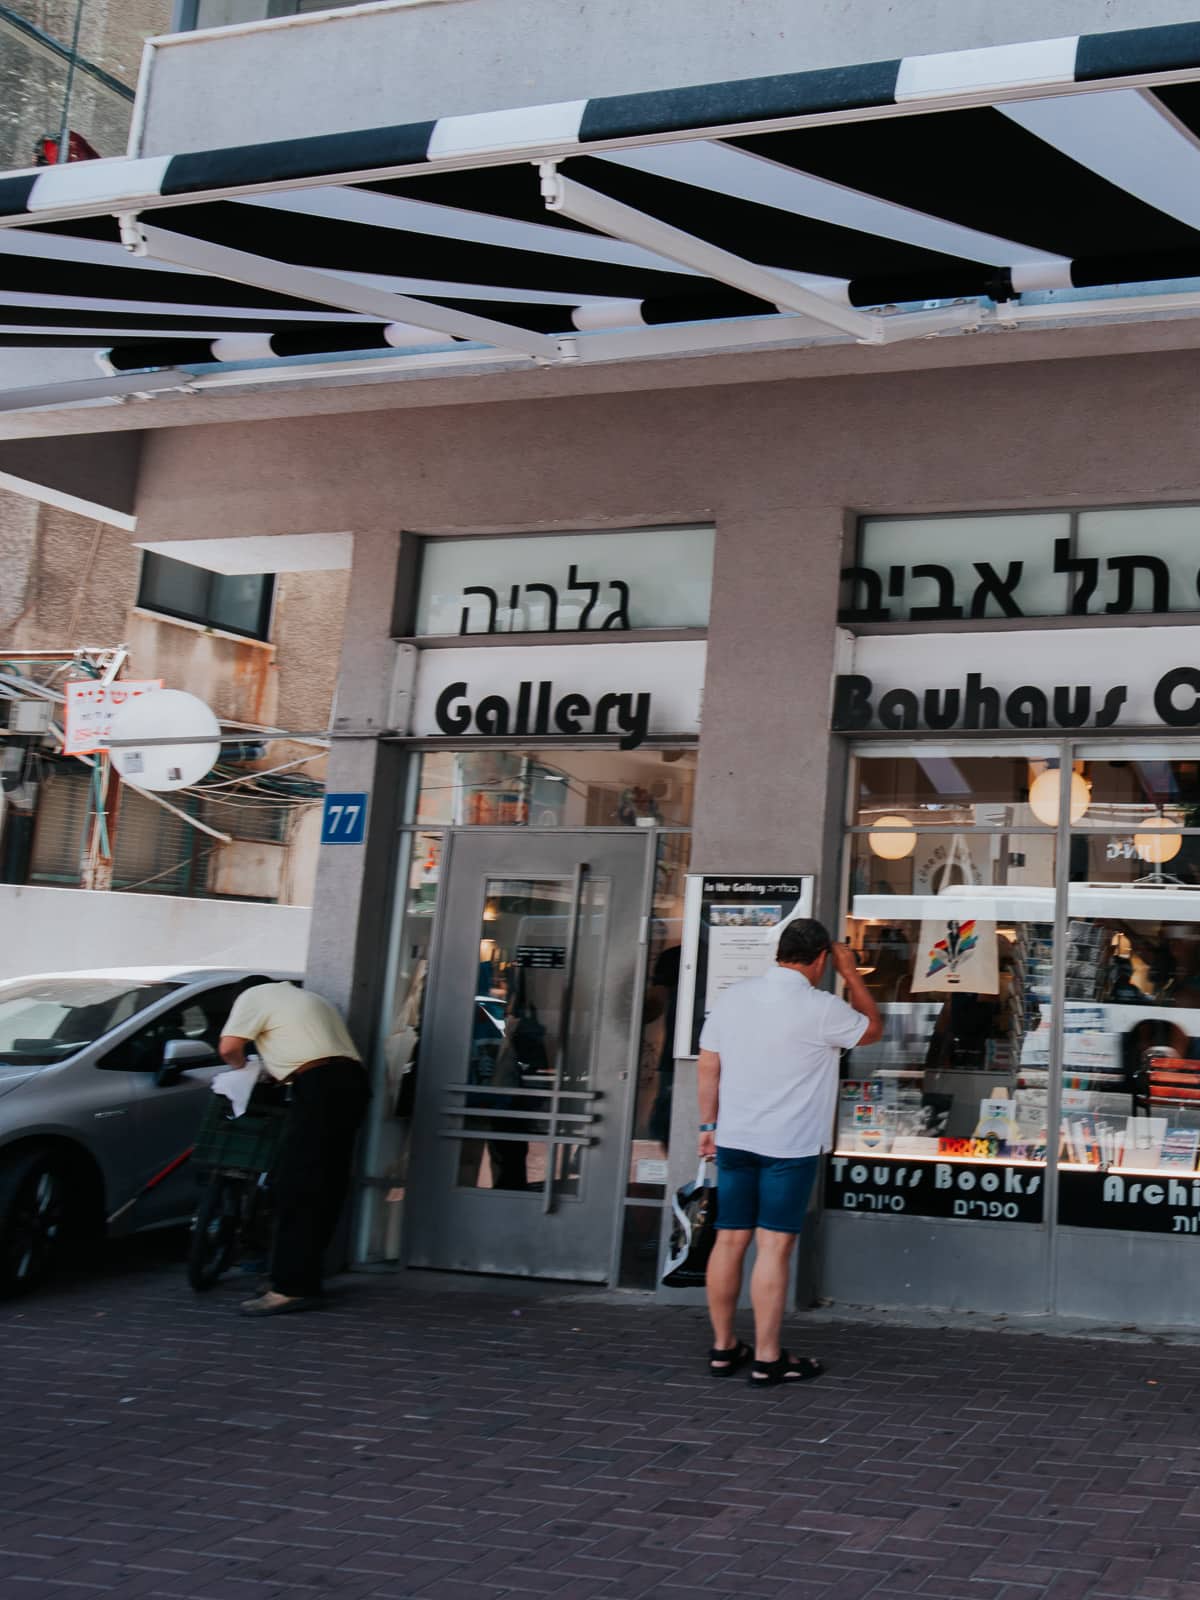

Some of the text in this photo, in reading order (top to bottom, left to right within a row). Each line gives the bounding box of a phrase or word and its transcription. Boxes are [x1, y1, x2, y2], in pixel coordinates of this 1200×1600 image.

[460, 565, 630, 635] גלריה
[838, 561, 1024, 622] אביב
[1054, 538, 1170, 615] תל
[436, 681, 651, 750] Gallery
[832, 672, 1127, 730] Bauhaus
[328, 805, 360, 834] 77
[832, 1158, 1040, 1195] Tours Books
[843, 1192, 906, 1211] סיורים
[954, 1199, 1019, 1219] ספרים
